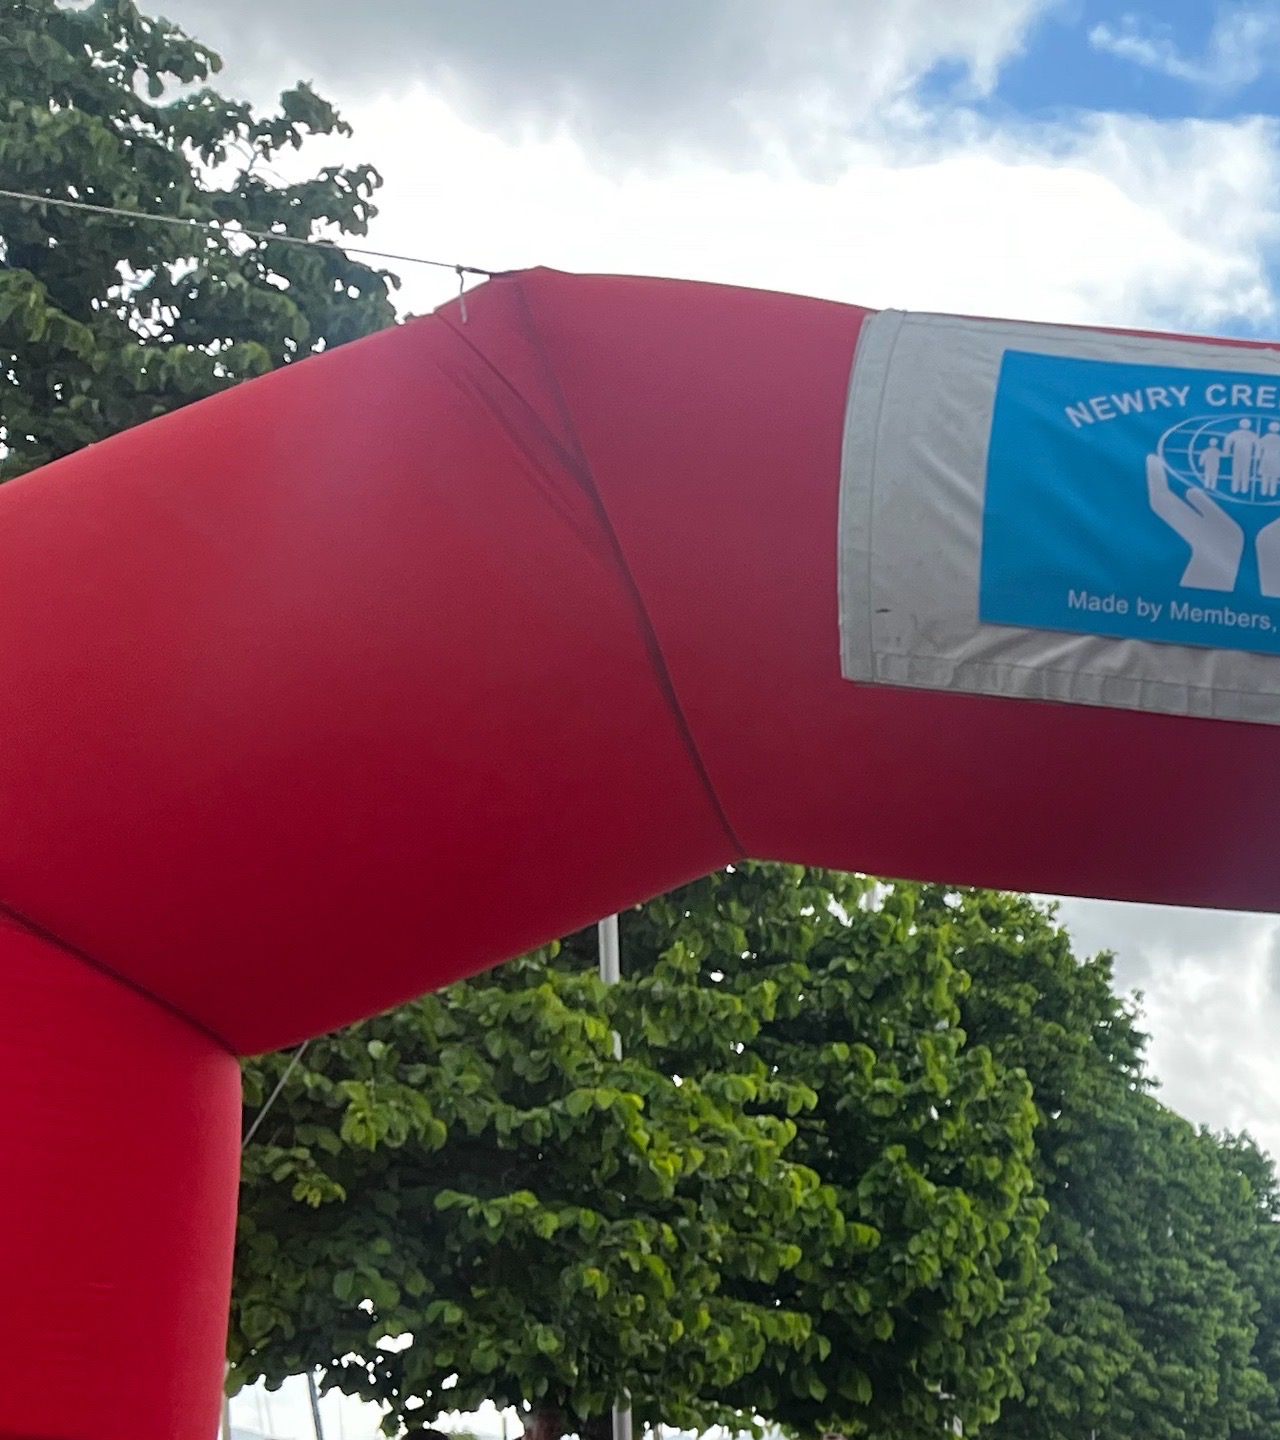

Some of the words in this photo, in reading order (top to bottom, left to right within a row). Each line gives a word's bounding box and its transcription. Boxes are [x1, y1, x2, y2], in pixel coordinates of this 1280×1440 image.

[1065, 385, 1190, 429] NEWRY
[1067, 589, 1129, 616] Made
[1136, 595, 1162, 622] by
[1169, 601, 1278, 634] Members,
